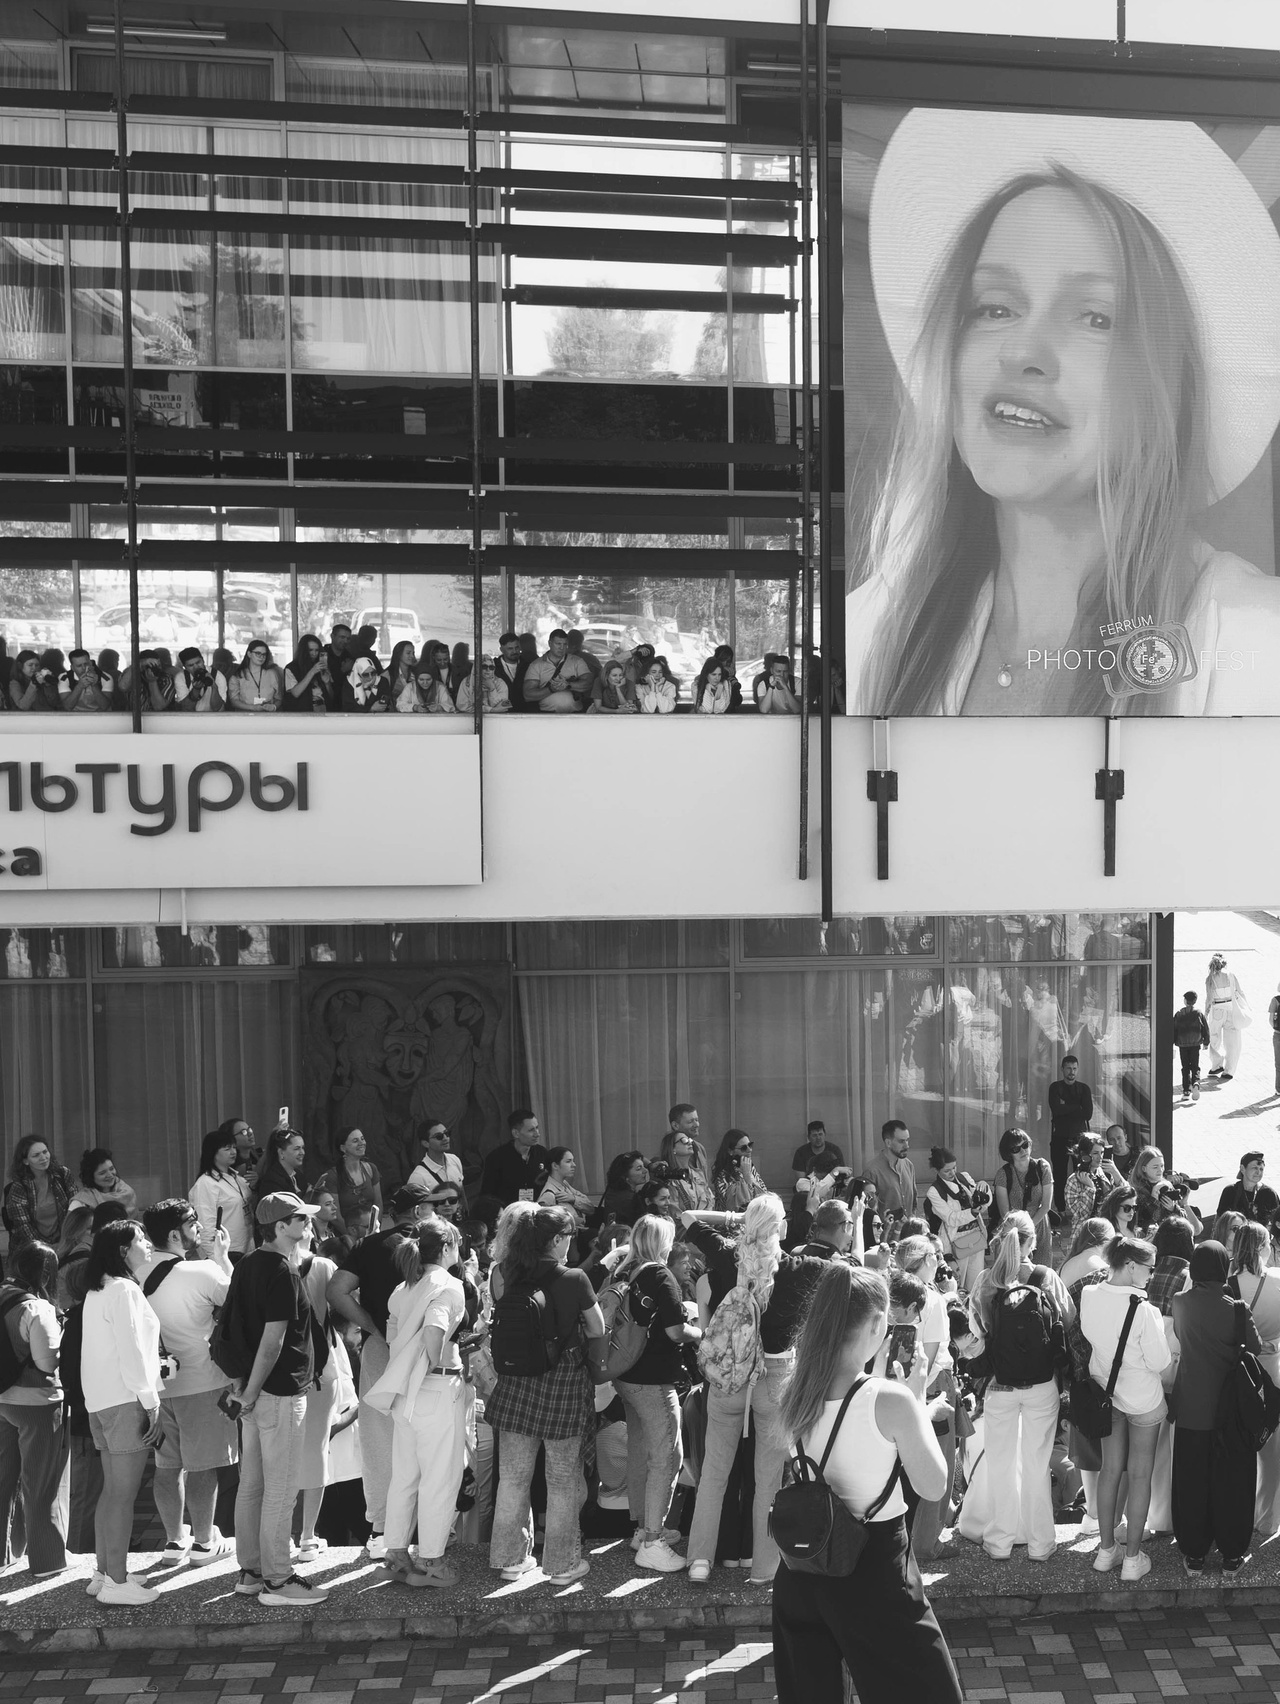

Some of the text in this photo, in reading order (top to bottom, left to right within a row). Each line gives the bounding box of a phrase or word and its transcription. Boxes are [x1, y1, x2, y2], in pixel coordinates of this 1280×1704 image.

[1099, 614, 1154, 637] FERRUM
[1027, 649, 1116, 670] PHOTO
[1200, 650, 1261, 671] FEST
